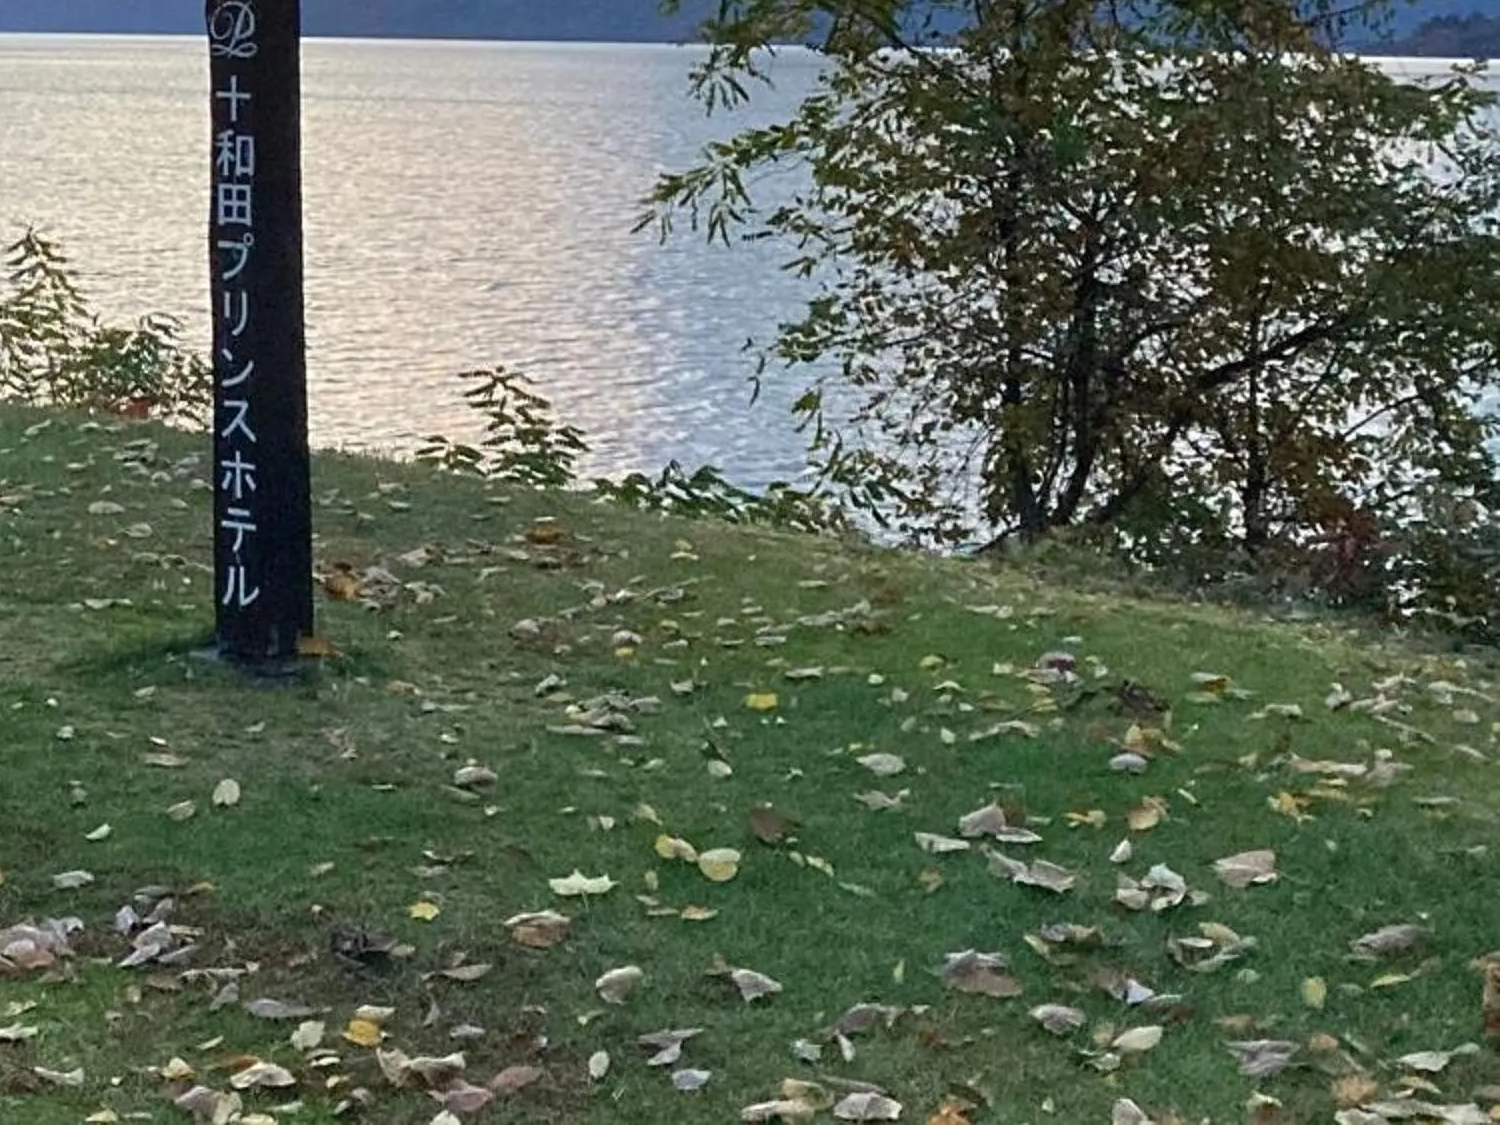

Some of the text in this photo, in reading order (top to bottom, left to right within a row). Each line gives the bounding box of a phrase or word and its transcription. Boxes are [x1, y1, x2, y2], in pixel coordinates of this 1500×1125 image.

[215, 75, 260, 607] 十和田プリンスホテル
